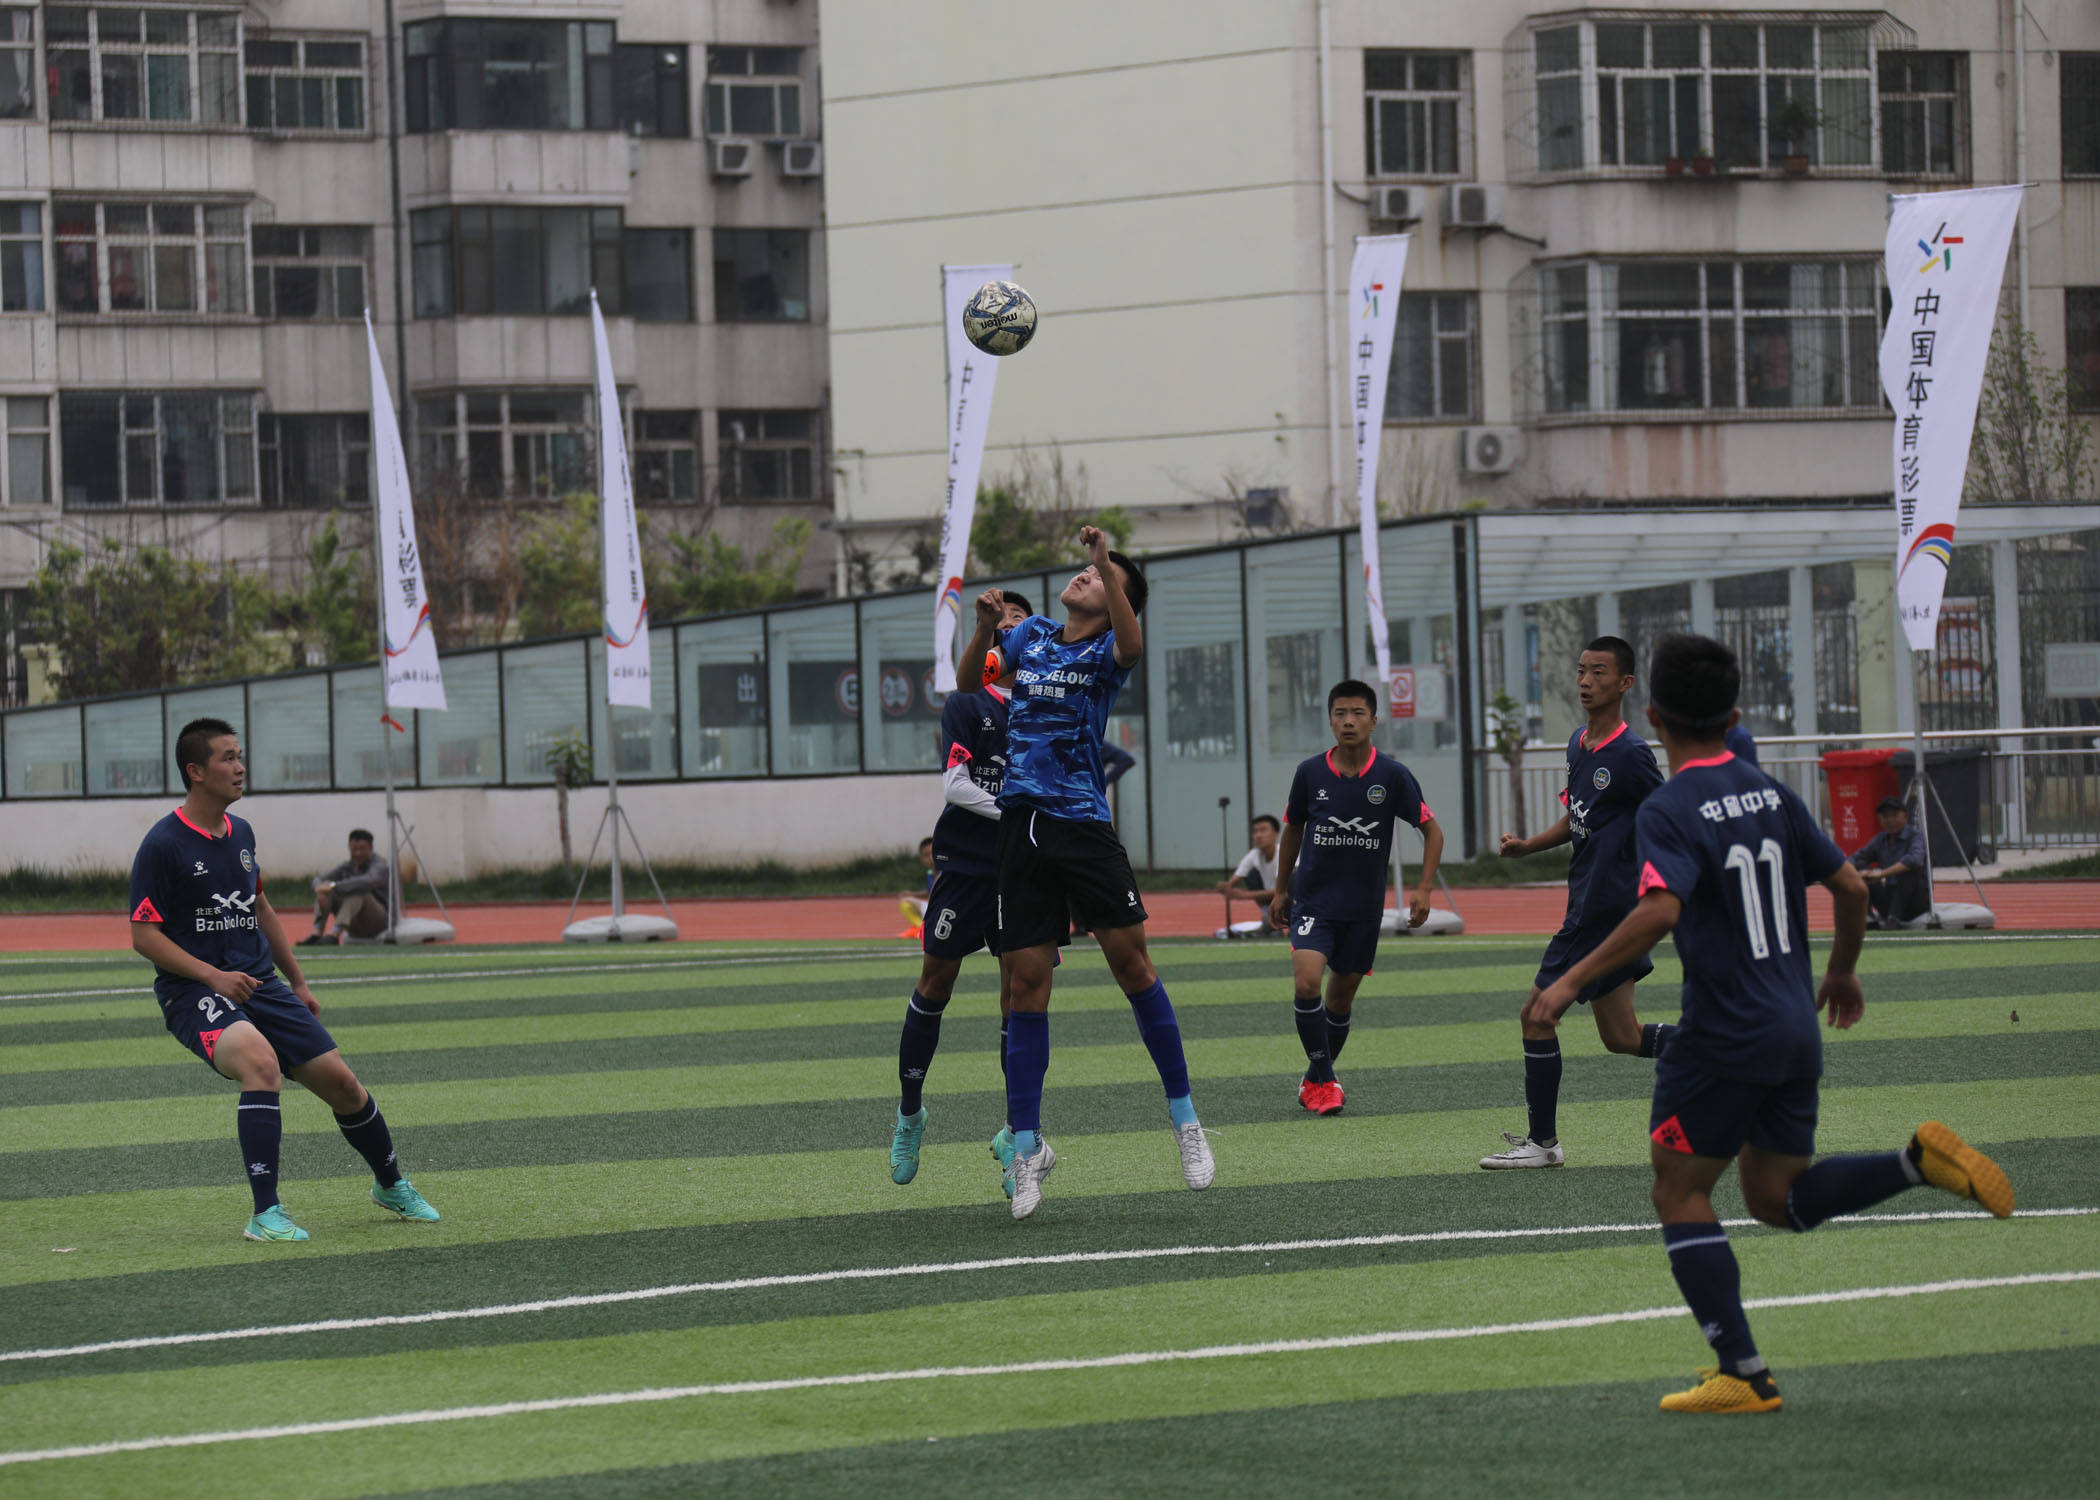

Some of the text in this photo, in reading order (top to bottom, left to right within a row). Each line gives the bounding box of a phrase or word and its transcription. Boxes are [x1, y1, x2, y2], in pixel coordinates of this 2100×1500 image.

[980, 312, 1018, 329] molten
[1900, 287, 1941, 536] 中国体育彩票
[1048, 670, 1094, 686] ELOVE
[1313, 833, 1380, 850] Bznbiology
[1724, 838, 1792, 960] 11
[934, 908, 957, 941] 6
[1297, 915, 1316, 936] 3
